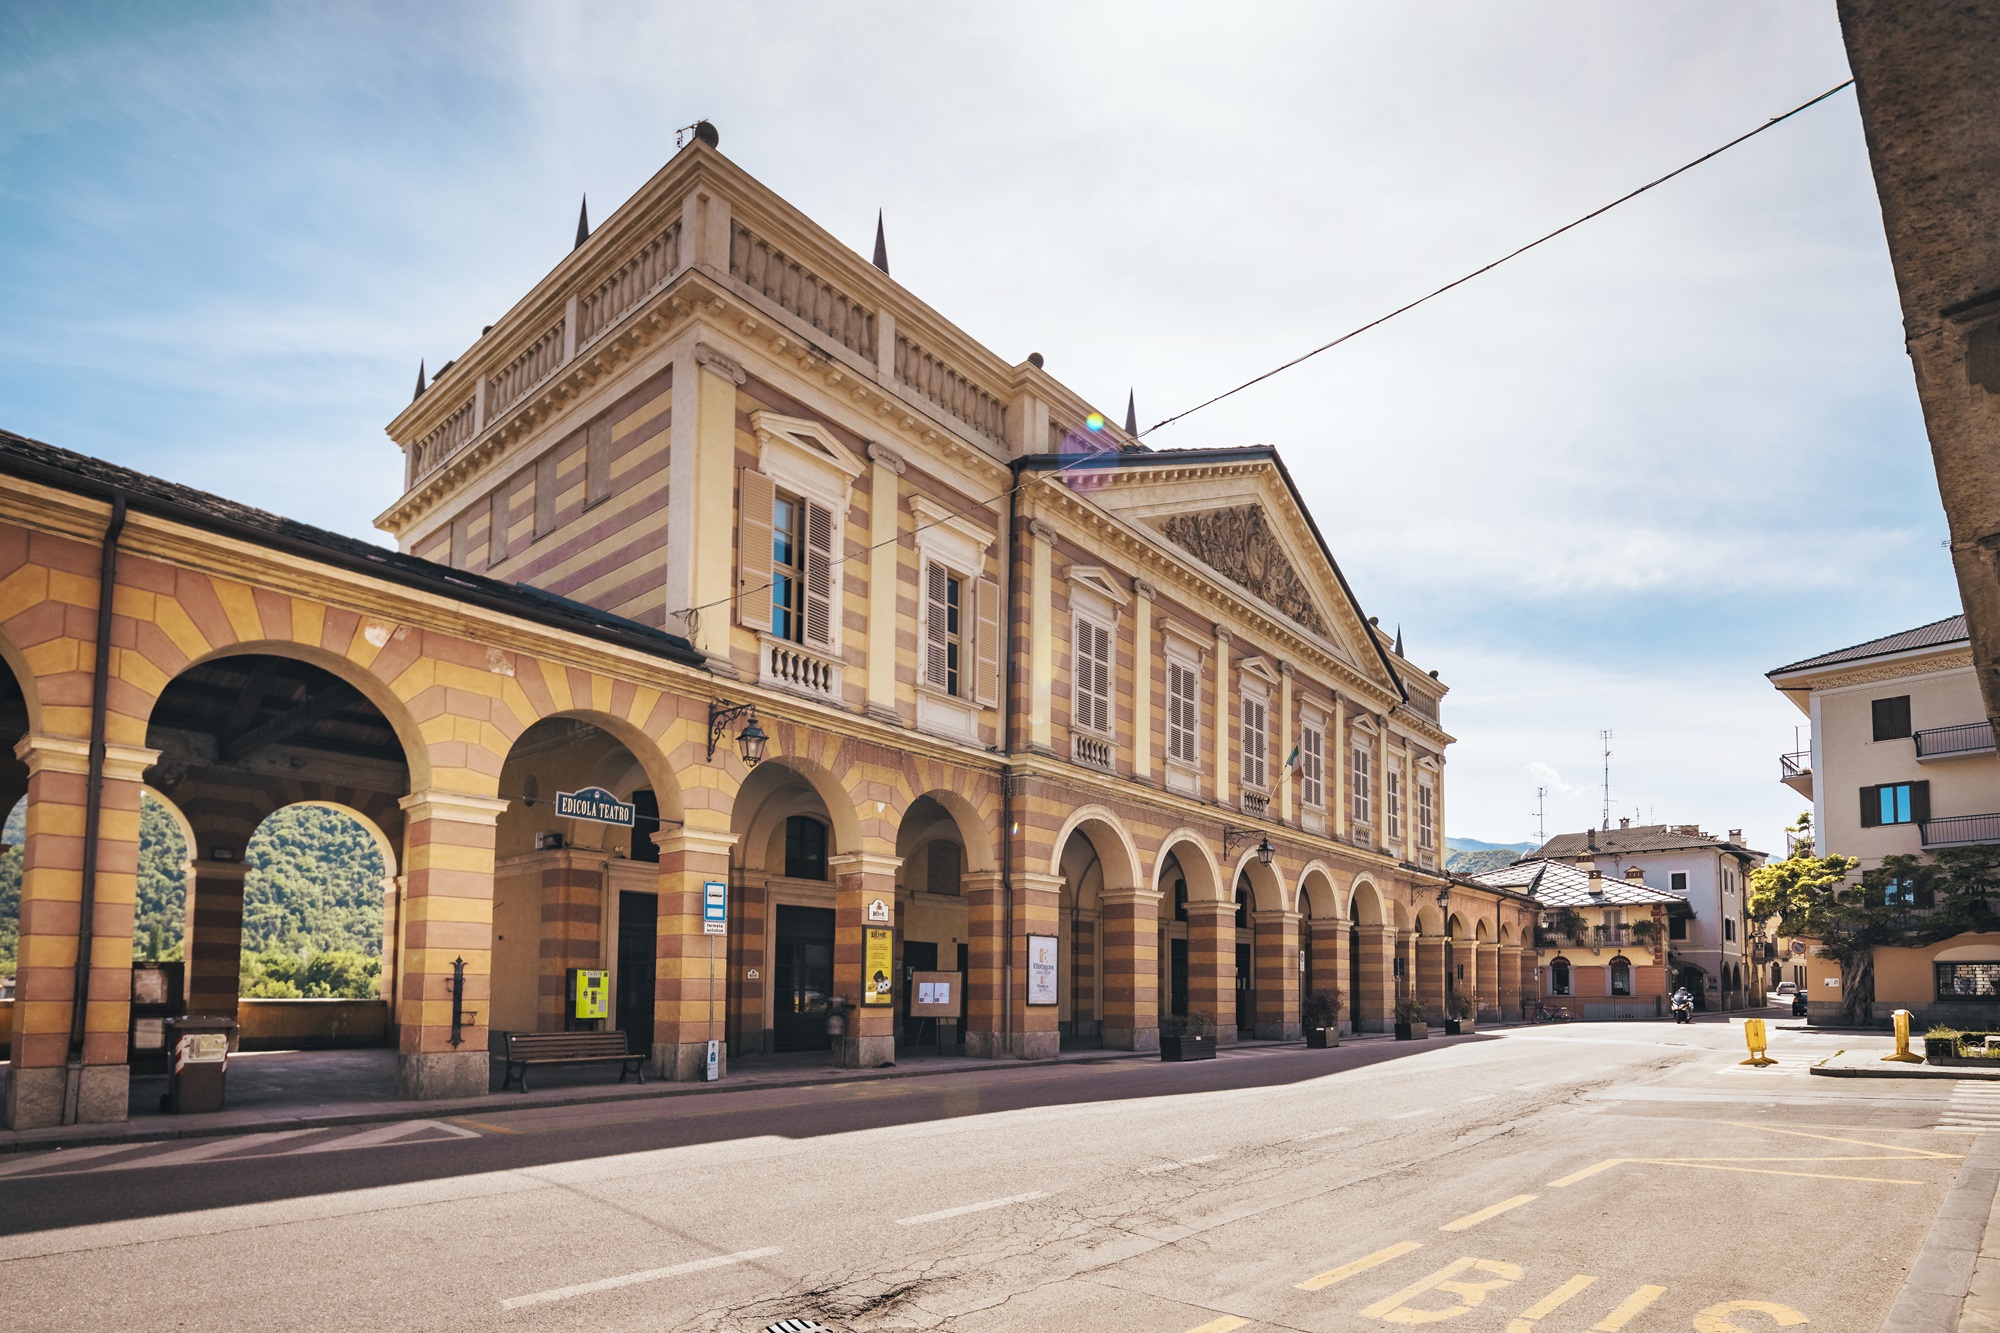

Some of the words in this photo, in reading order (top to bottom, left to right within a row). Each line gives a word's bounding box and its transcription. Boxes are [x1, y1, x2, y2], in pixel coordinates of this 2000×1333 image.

[562, 797, 596, 817] EDICOLA
[599, 803, 629, 821] TEATRO
[871, 930, 887, 939] Blink
